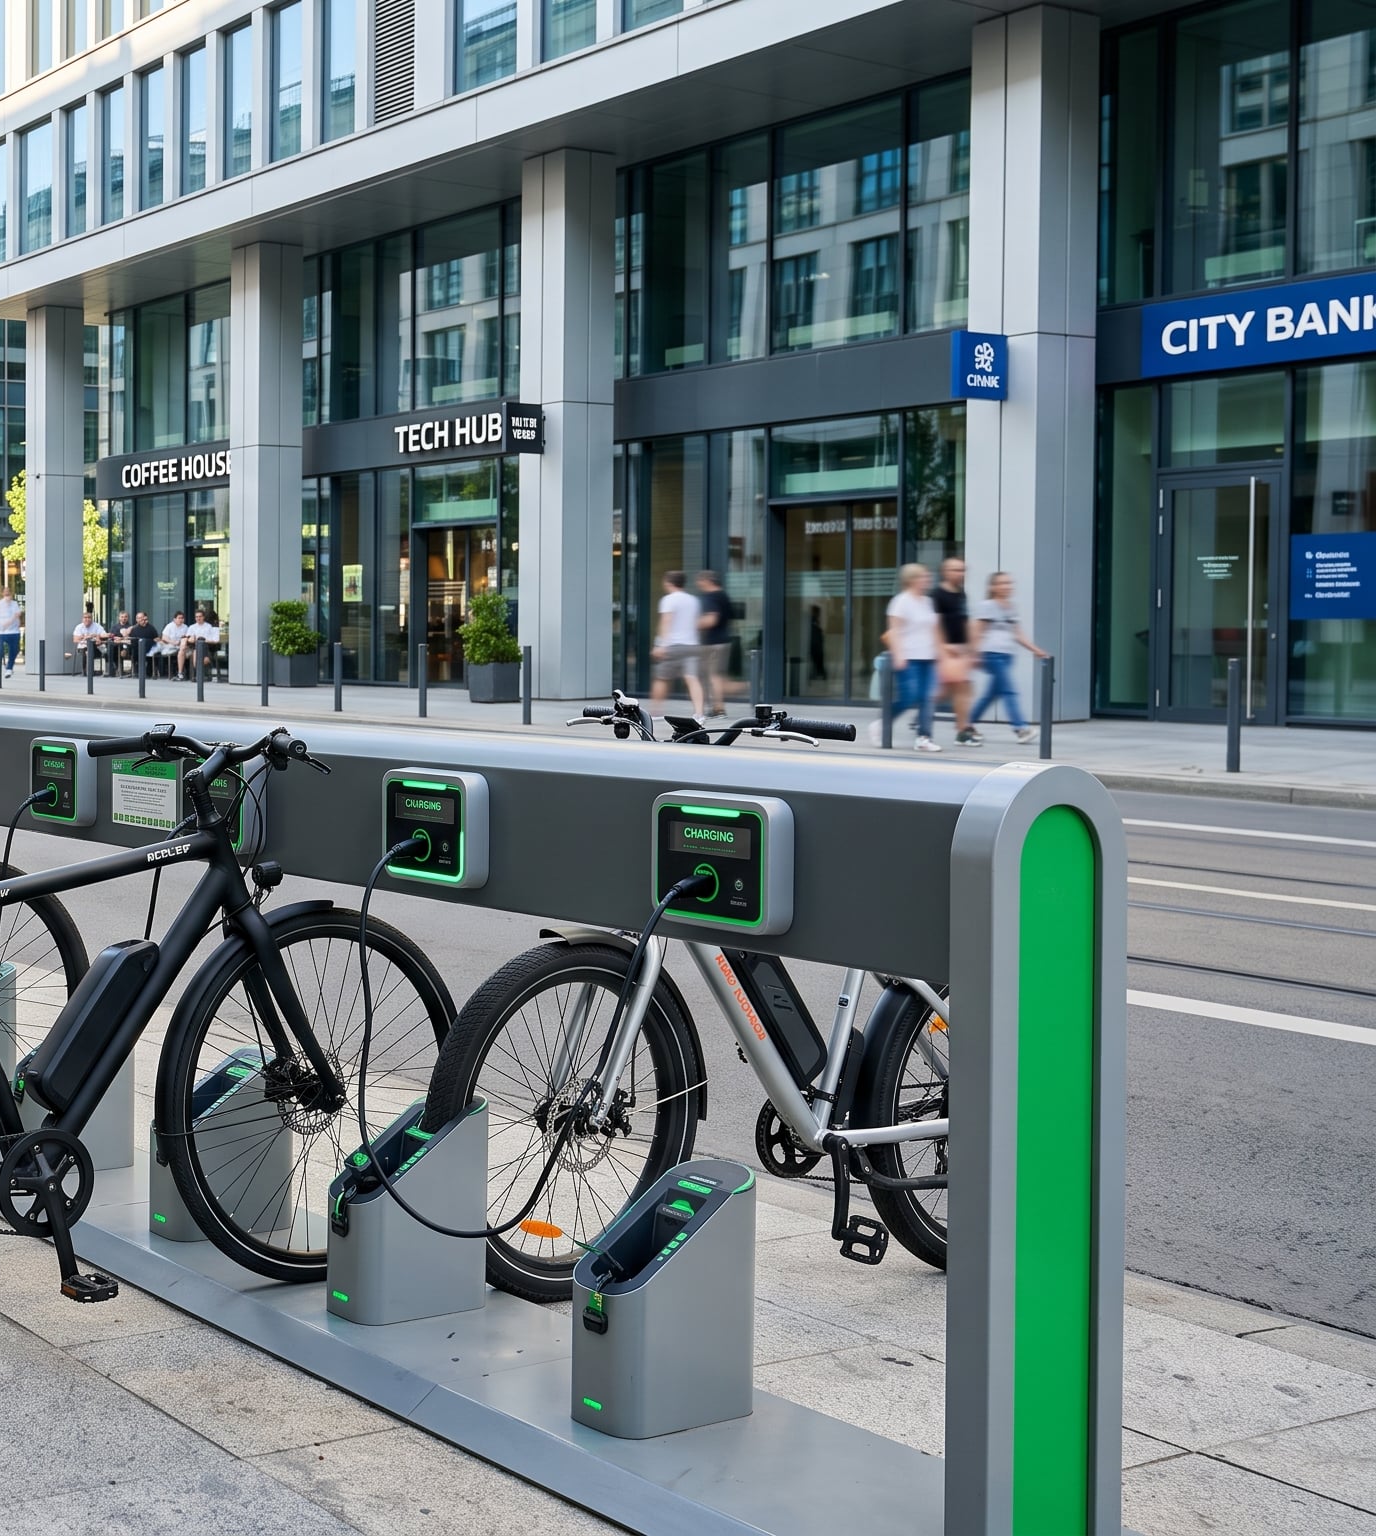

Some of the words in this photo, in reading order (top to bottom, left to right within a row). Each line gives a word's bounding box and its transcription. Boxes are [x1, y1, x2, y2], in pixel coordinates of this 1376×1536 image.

[1161, 310, 1255, 355] CITY
[394, 419, 449, 453] TECH
[455, 412, 502, 446] HUB
[121, 458, 178, 488] COFFEE
[684, 827, 734, 843] CHARGING
